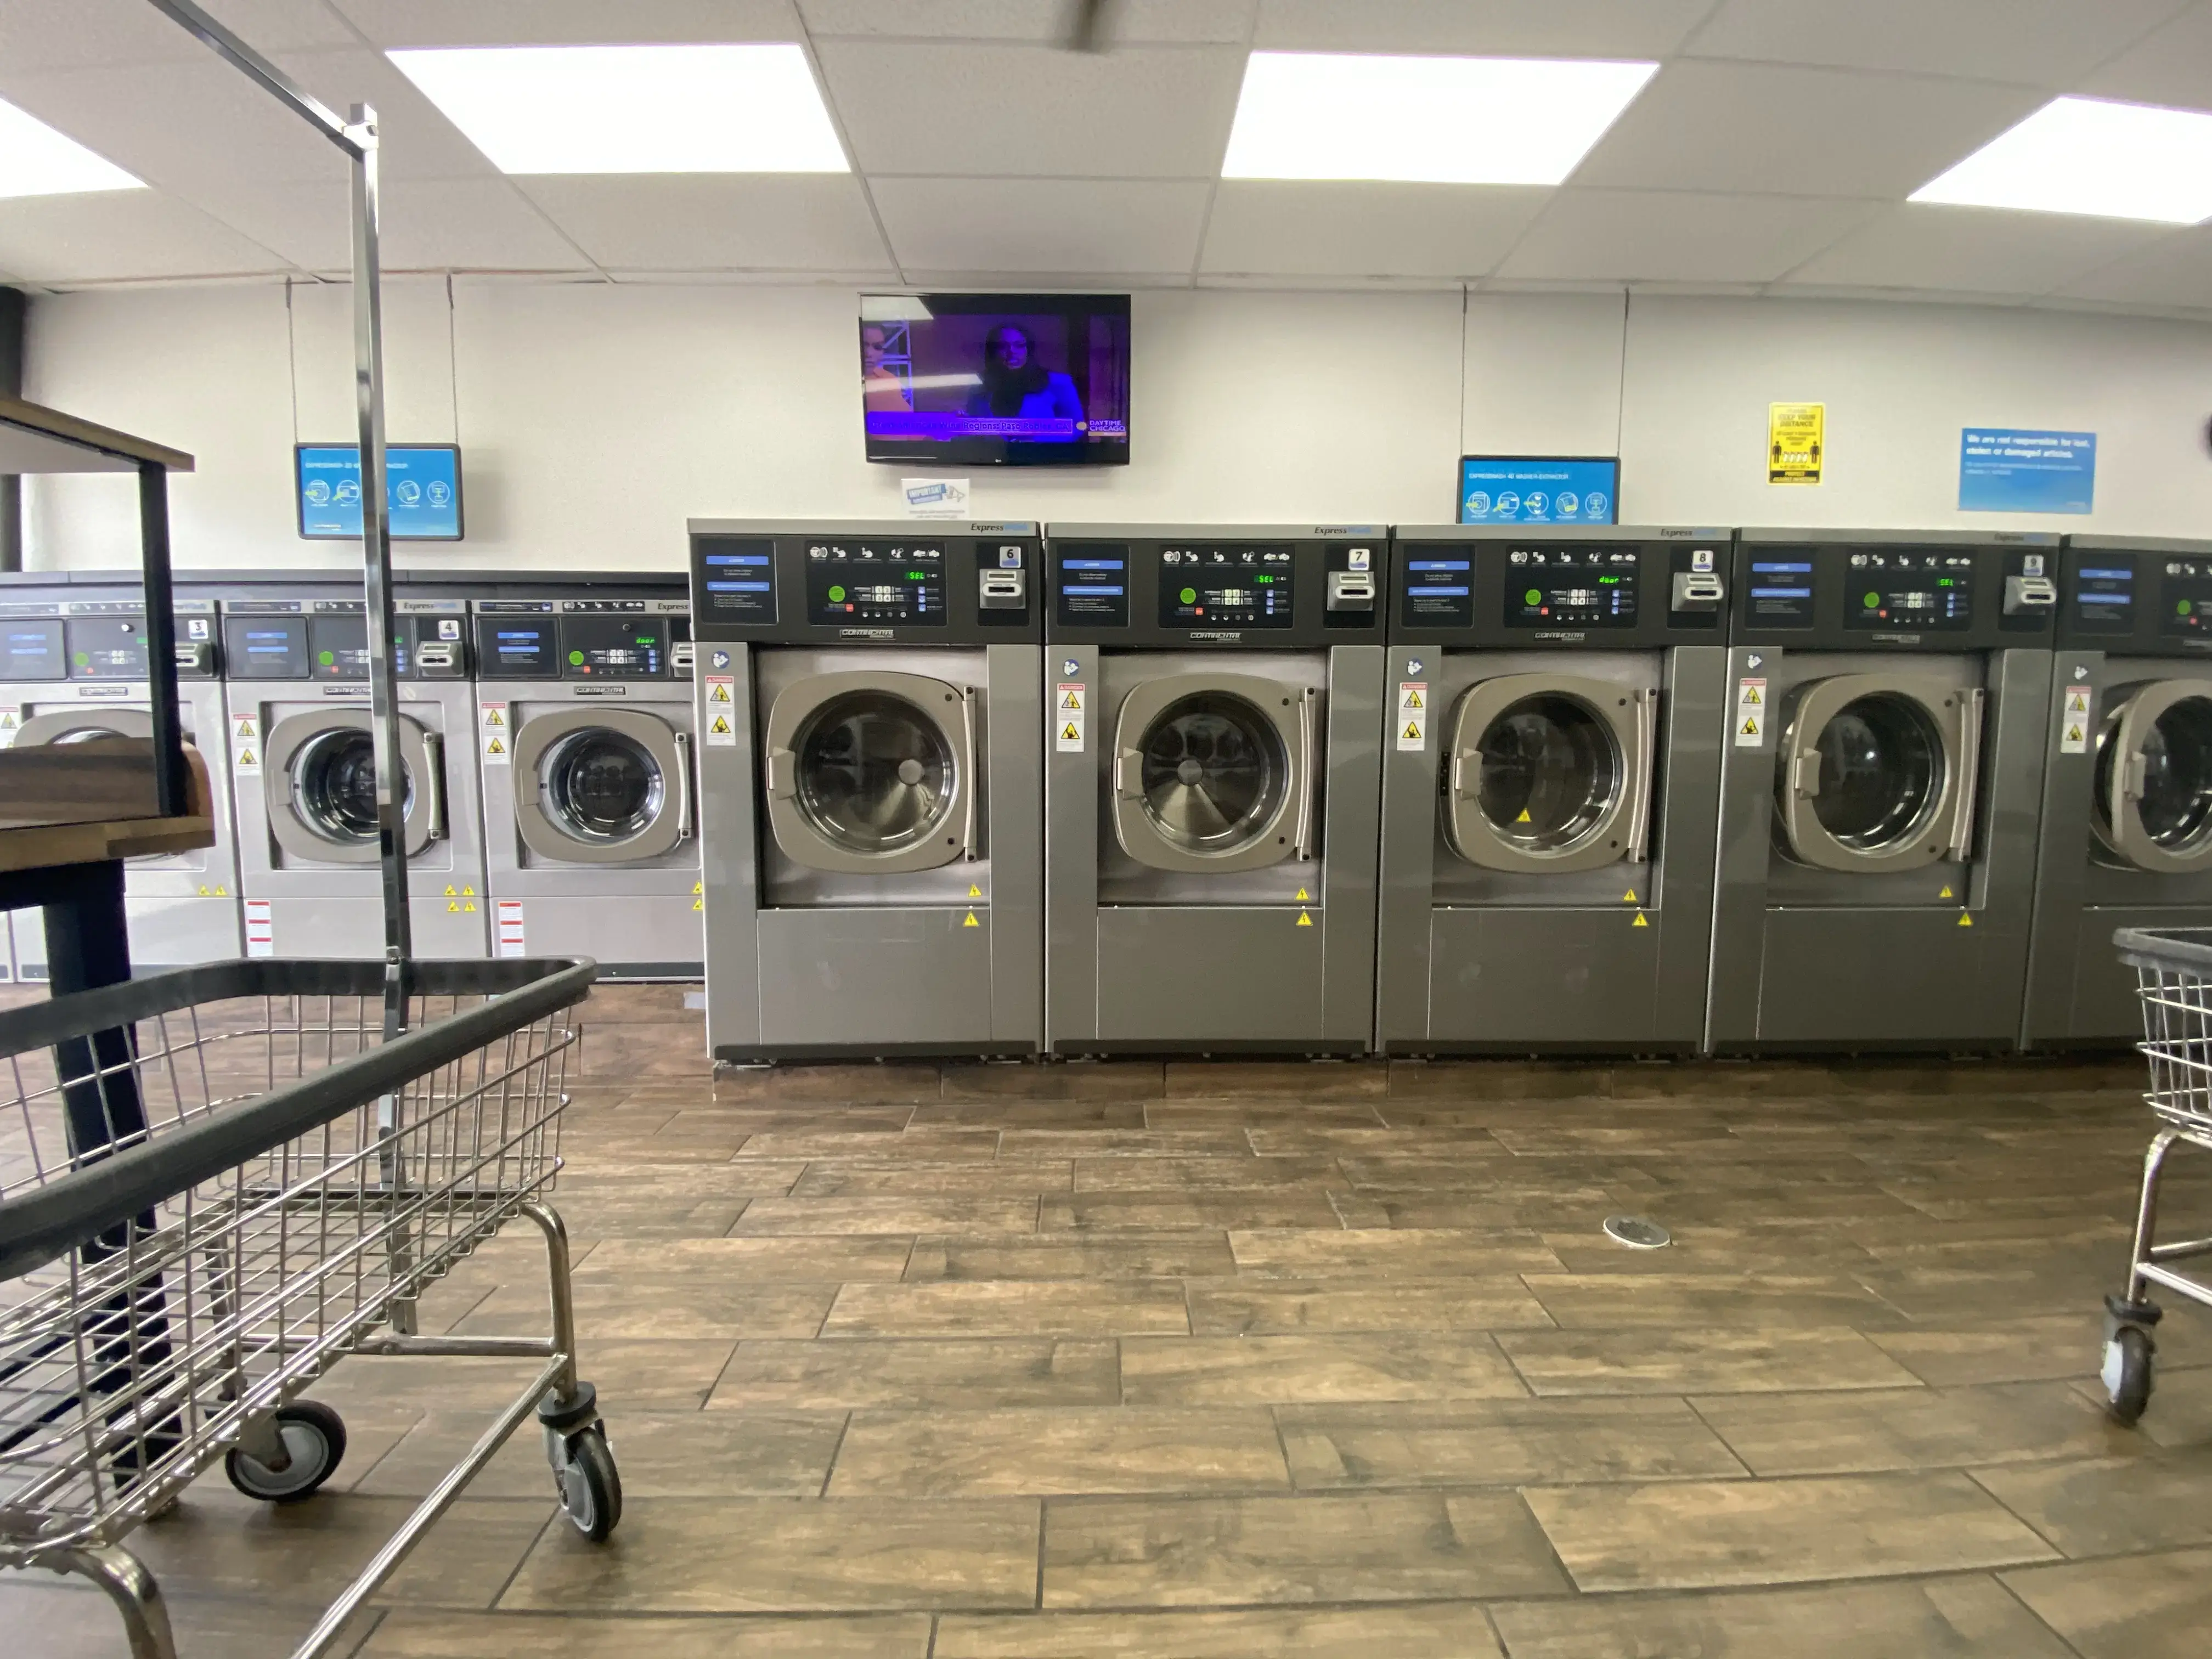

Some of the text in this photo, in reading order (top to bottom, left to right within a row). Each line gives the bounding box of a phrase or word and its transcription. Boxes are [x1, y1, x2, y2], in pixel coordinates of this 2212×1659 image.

[1007, 549, 1014, 558] 6
[1355, 551, 1363, 561] 7
[1699, 552, 1706, 562] 8
[194, 622, 202, 631] 3
[444, 622, 453, 631] 4
